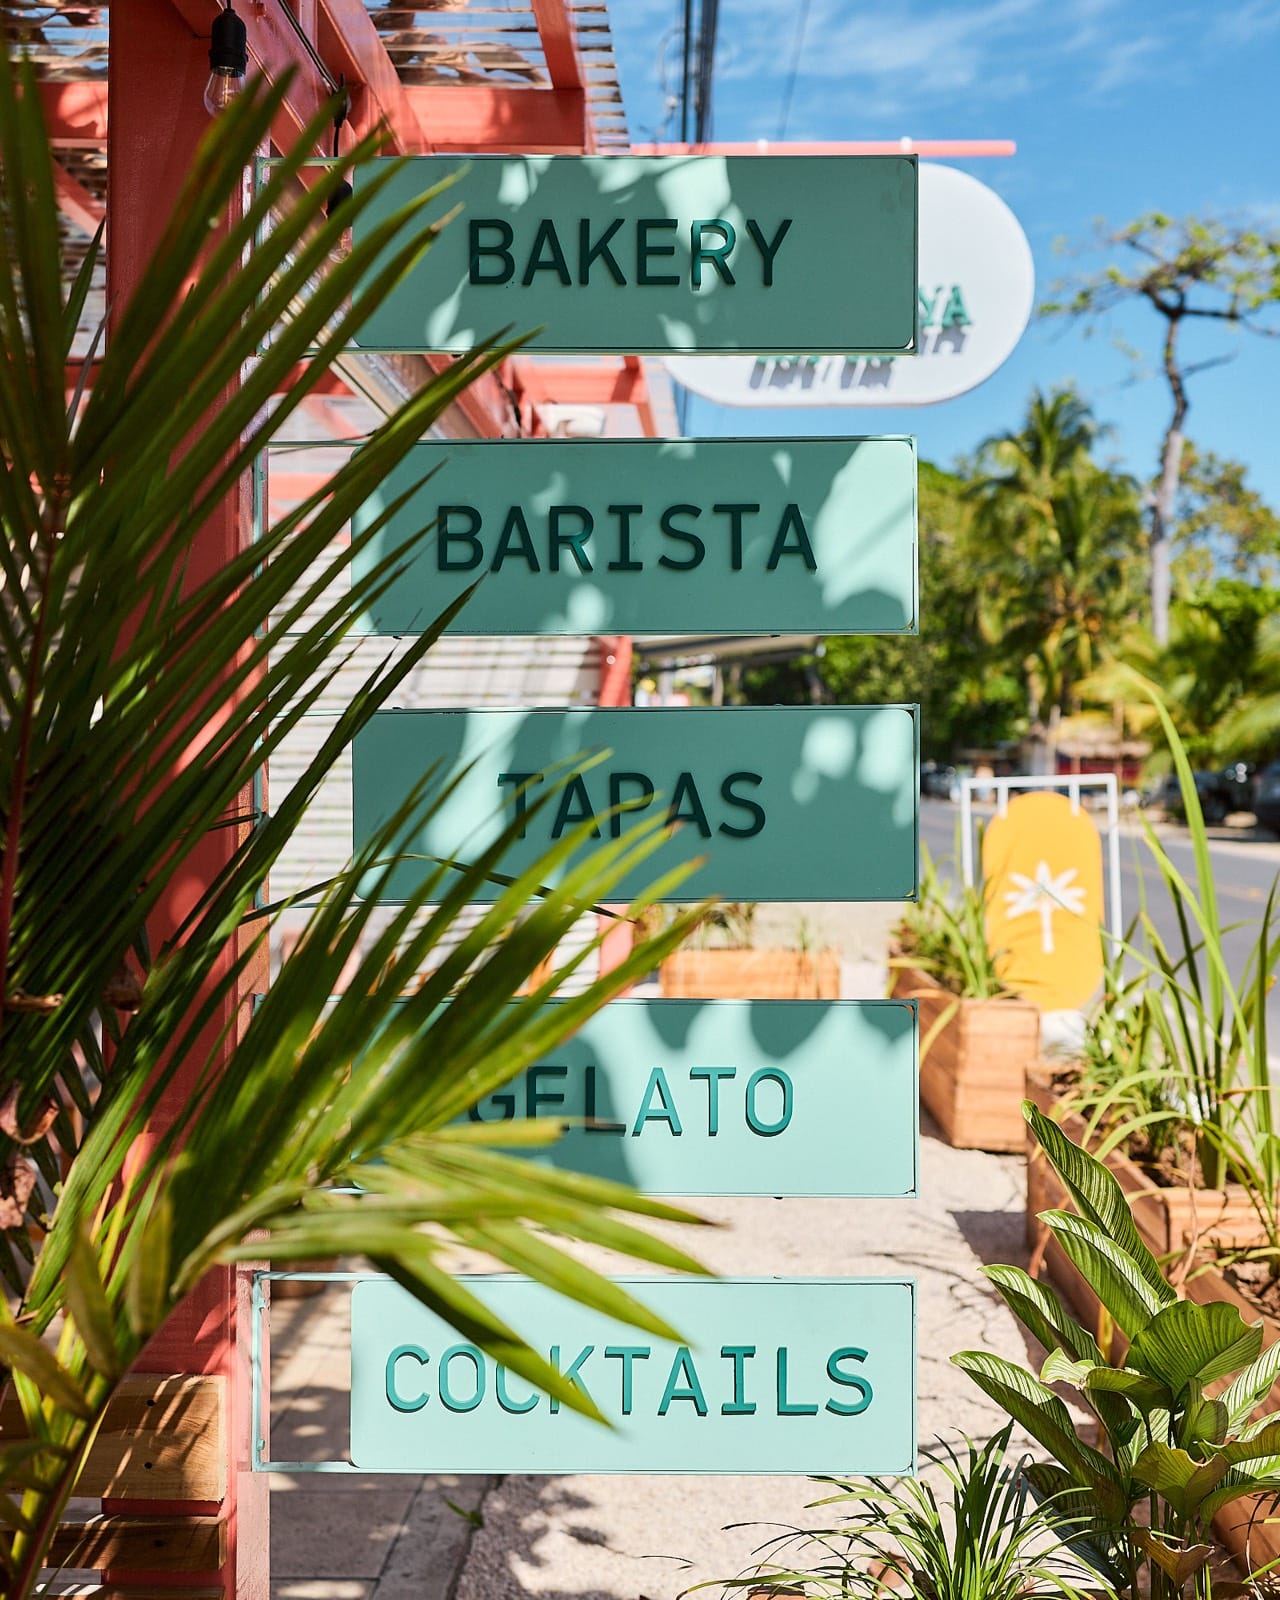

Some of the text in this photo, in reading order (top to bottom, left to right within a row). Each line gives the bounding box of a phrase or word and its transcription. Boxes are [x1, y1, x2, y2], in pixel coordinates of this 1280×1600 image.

[469, 218, 793, 288] BAKERY
[437, 503, 818, 572] BARISTA
[497, 771, 766, 839] TAPAS
[469, 1066, 794, 1137] GELATO
[385, 1344, 875, 1416] COCKTAILS
